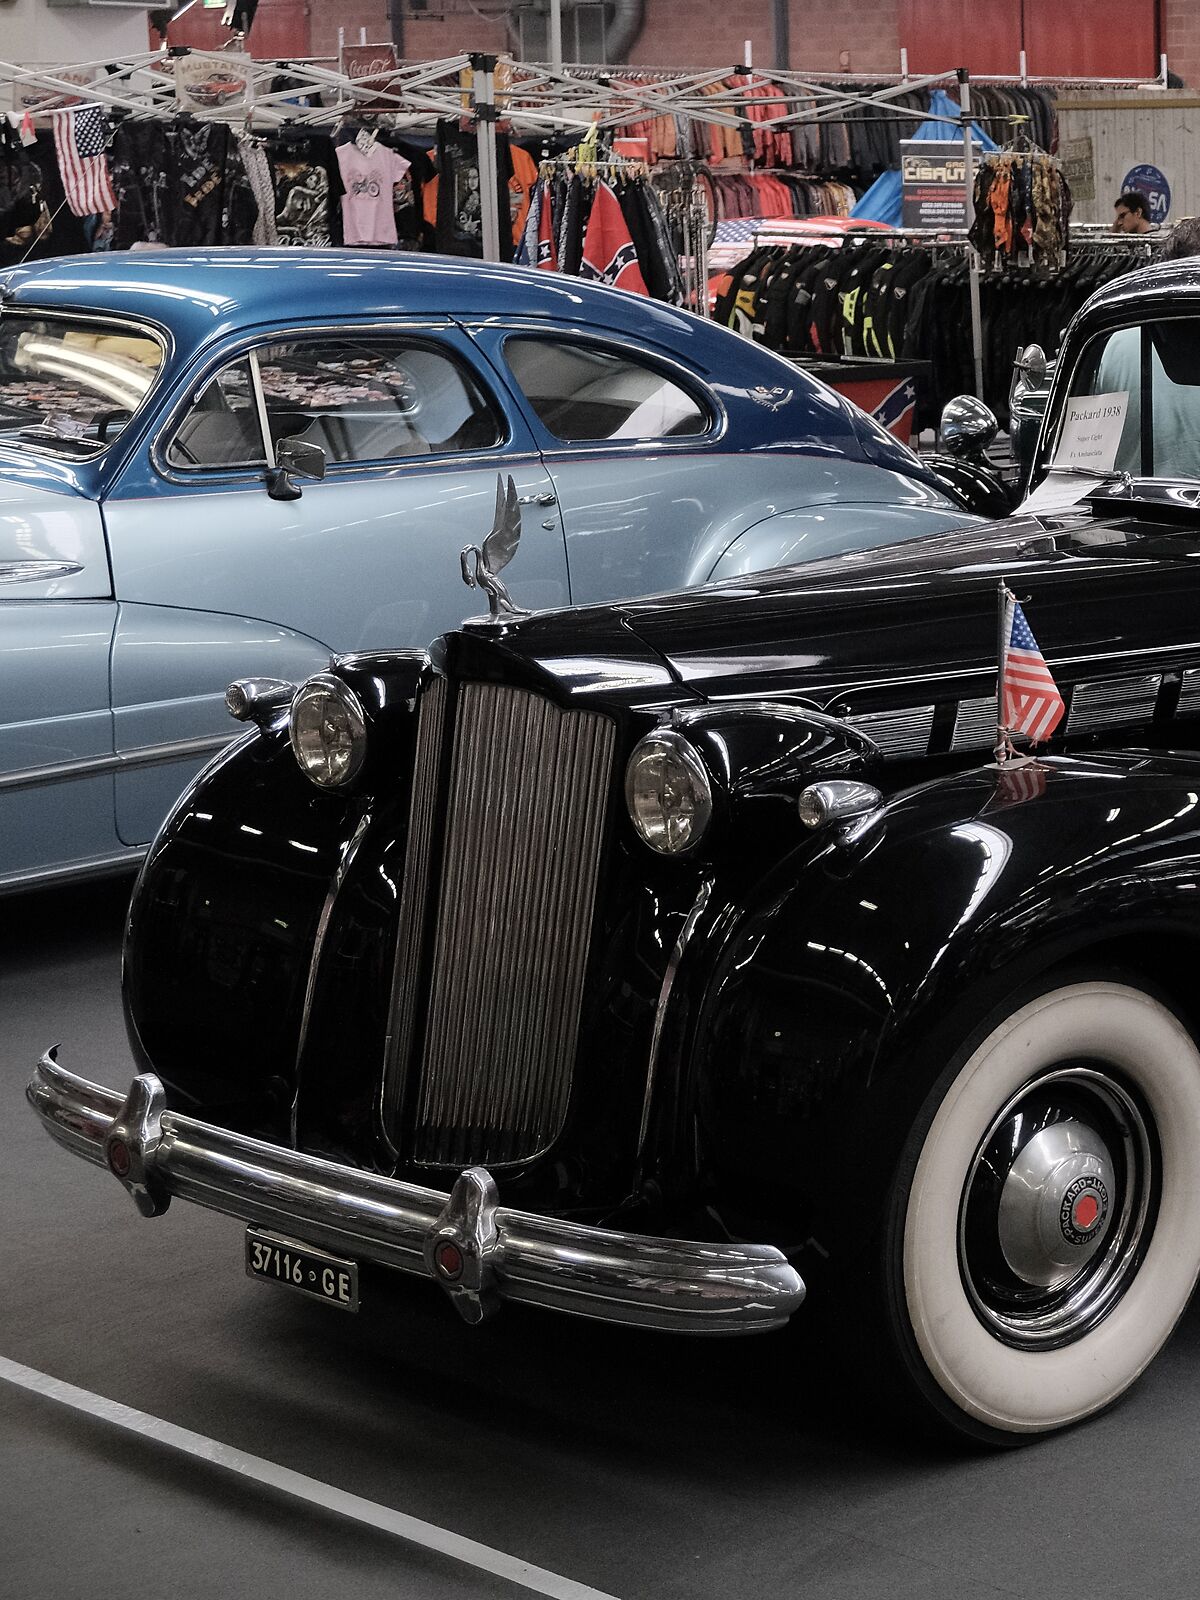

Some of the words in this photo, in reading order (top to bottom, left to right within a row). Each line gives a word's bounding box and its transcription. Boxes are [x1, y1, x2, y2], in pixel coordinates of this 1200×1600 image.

[1070, 408, 1101, 421] Packard
[1103, 405, 1122, 418] 1938
[1062, 1178, 1087, 1236] PACKARD
[252, 1242, 303, 1283] 37116
[322, 1268, 350, 1301] GE
